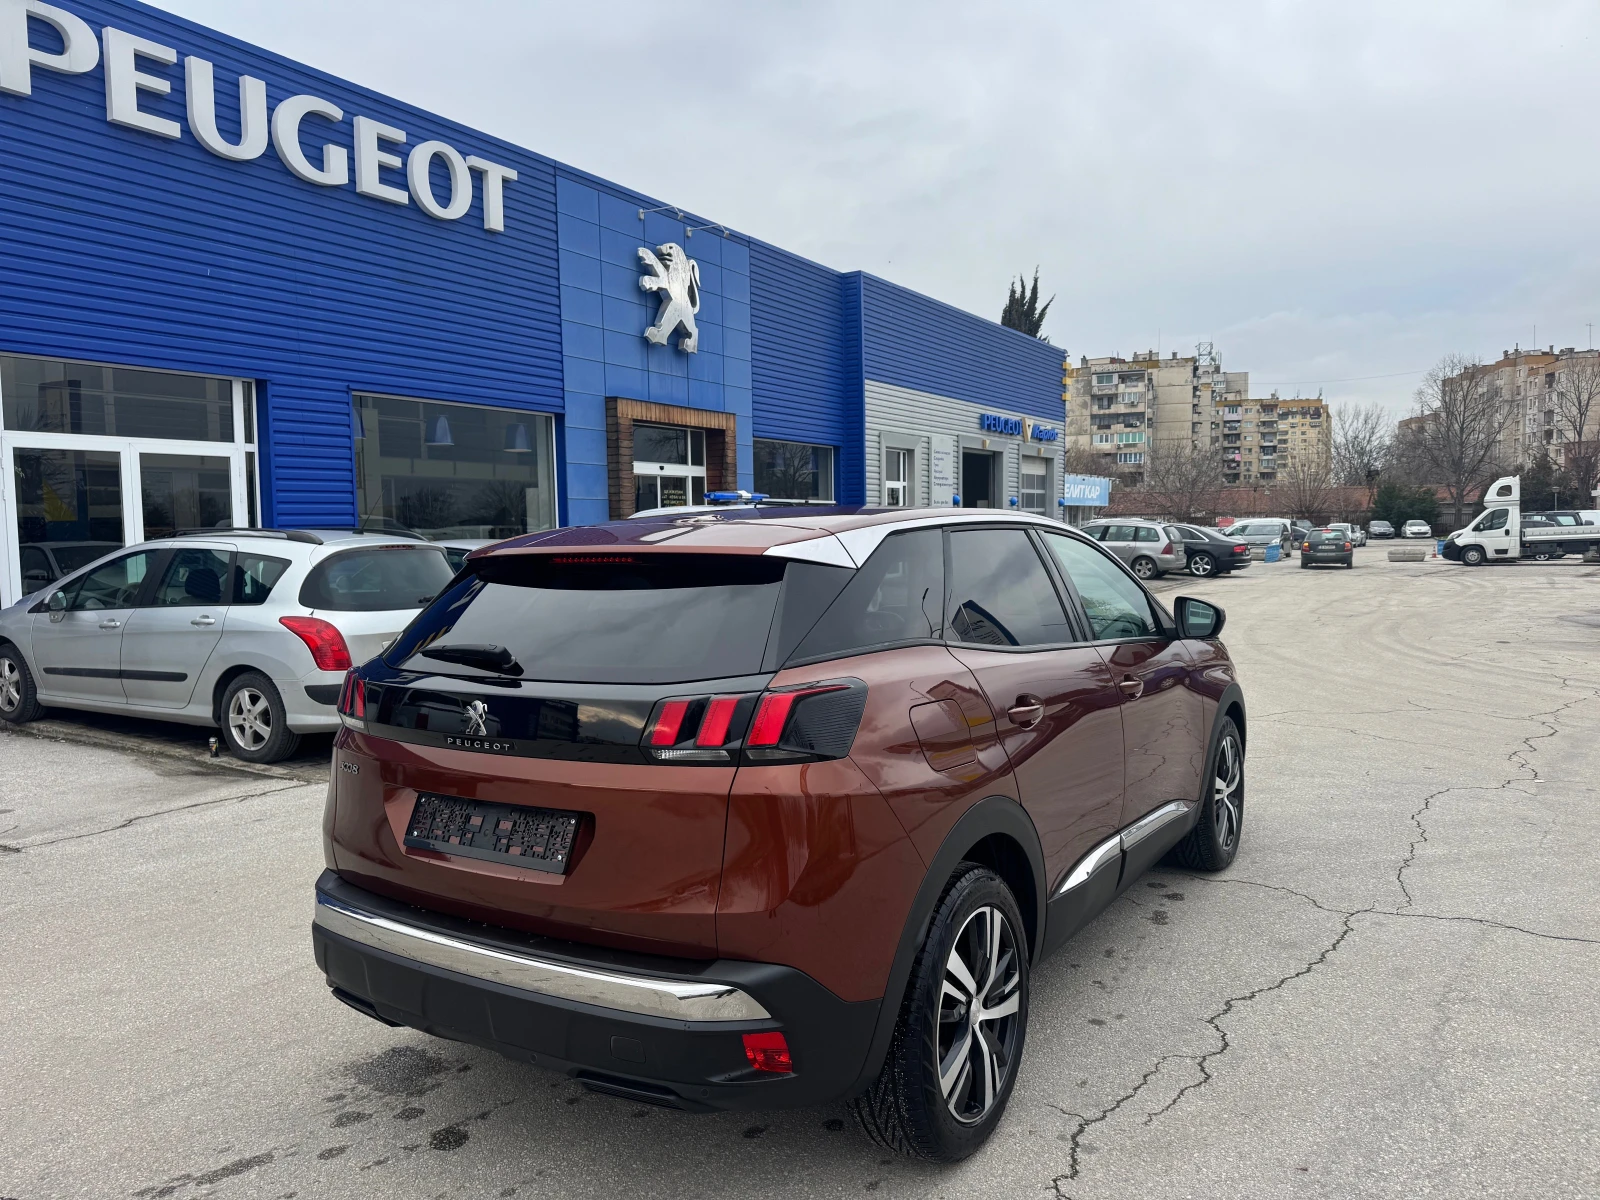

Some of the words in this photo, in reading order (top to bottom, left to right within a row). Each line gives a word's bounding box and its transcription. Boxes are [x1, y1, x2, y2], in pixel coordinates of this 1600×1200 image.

[0, 0, 518, 233] PEUGEOT
[980, 413, 1022, 435] PEUGEOT
[447, 737, 510, 751] PEUGEOT
[340, 761, 359, 775] 3008
